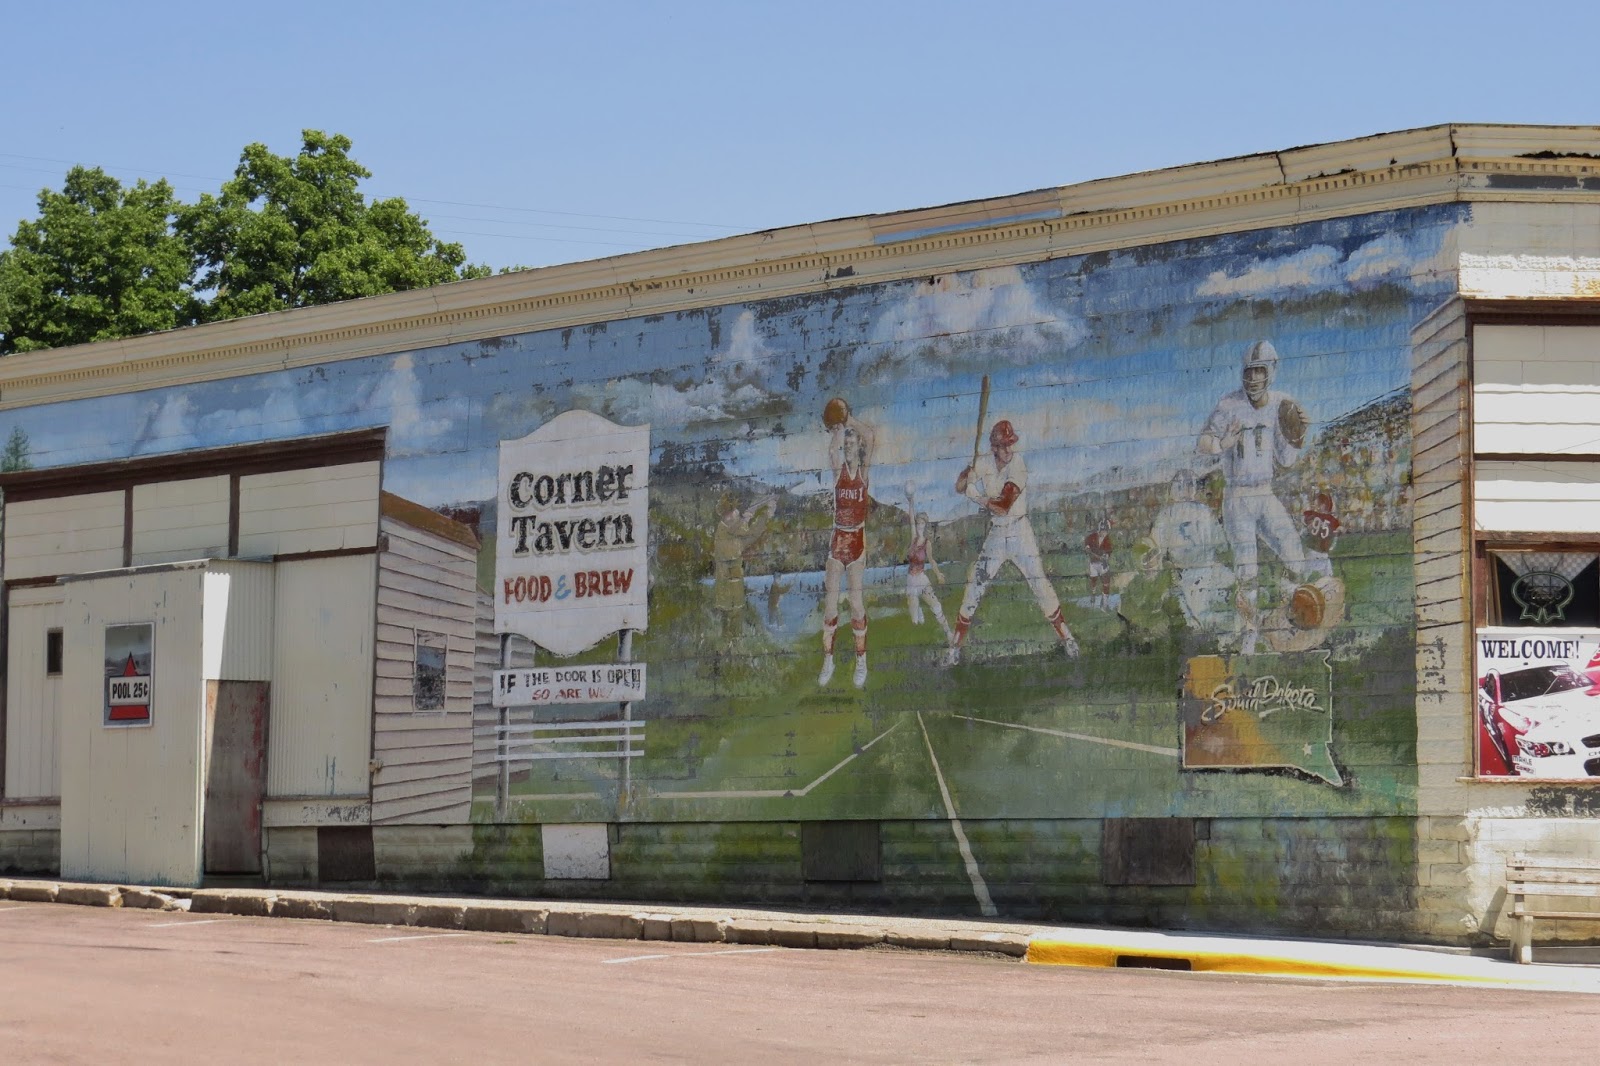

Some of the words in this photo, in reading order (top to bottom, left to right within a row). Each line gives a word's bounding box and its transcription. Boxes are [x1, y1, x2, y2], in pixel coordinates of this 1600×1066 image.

[510, 464, 634, 509] Corner
[511, 513, 635, 554] Tavern
[1311, 516, 1331, 539] 95
[504, 575, 552, 604] FOOD
[554, 575, 572, 600] &
[574, 568, 634, 598] BREW
[1482, 640, 1579, 658] WELCOME!
[112, 682, 131, 699] POOL
[134, 682, 148, 698] 25¢
[500, 673, 516, 694] IF
[524, 672, 549, 687] THE
[555, 670, 587, 683] DOOR
[592, 669, 602, 683] IS
[607, 668, 641, 688] OPEN
[532, 688, 550, 700] SO
[555, 688, 582, 699] ARE
[1252, 675, 1326, 713] Dakota
